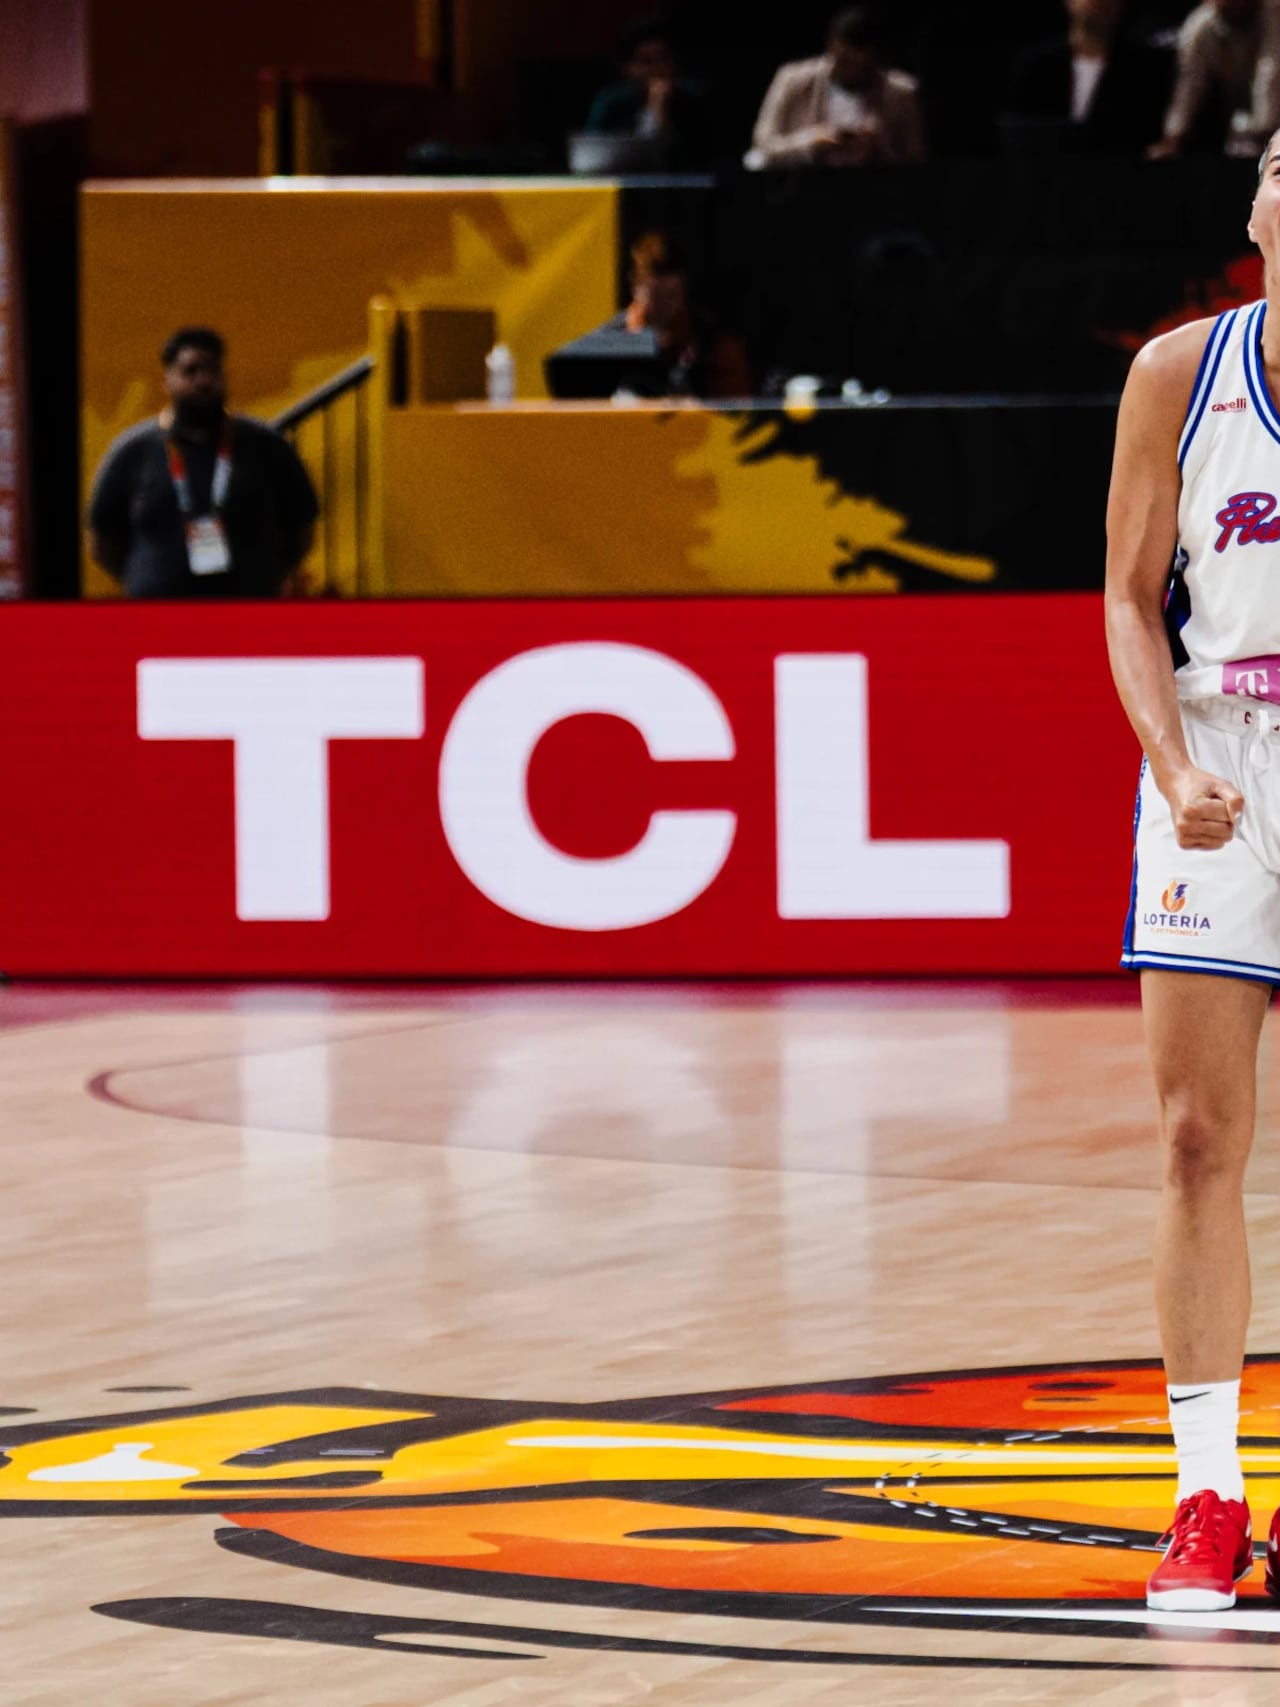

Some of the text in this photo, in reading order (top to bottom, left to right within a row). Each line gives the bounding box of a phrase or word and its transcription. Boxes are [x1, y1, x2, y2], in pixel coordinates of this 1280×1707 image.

[1212, 398, 1247, 412] caelli
[136, 641, 1011, 931] TCL
[1143, 913, 1211, 929] LOTERÍA
